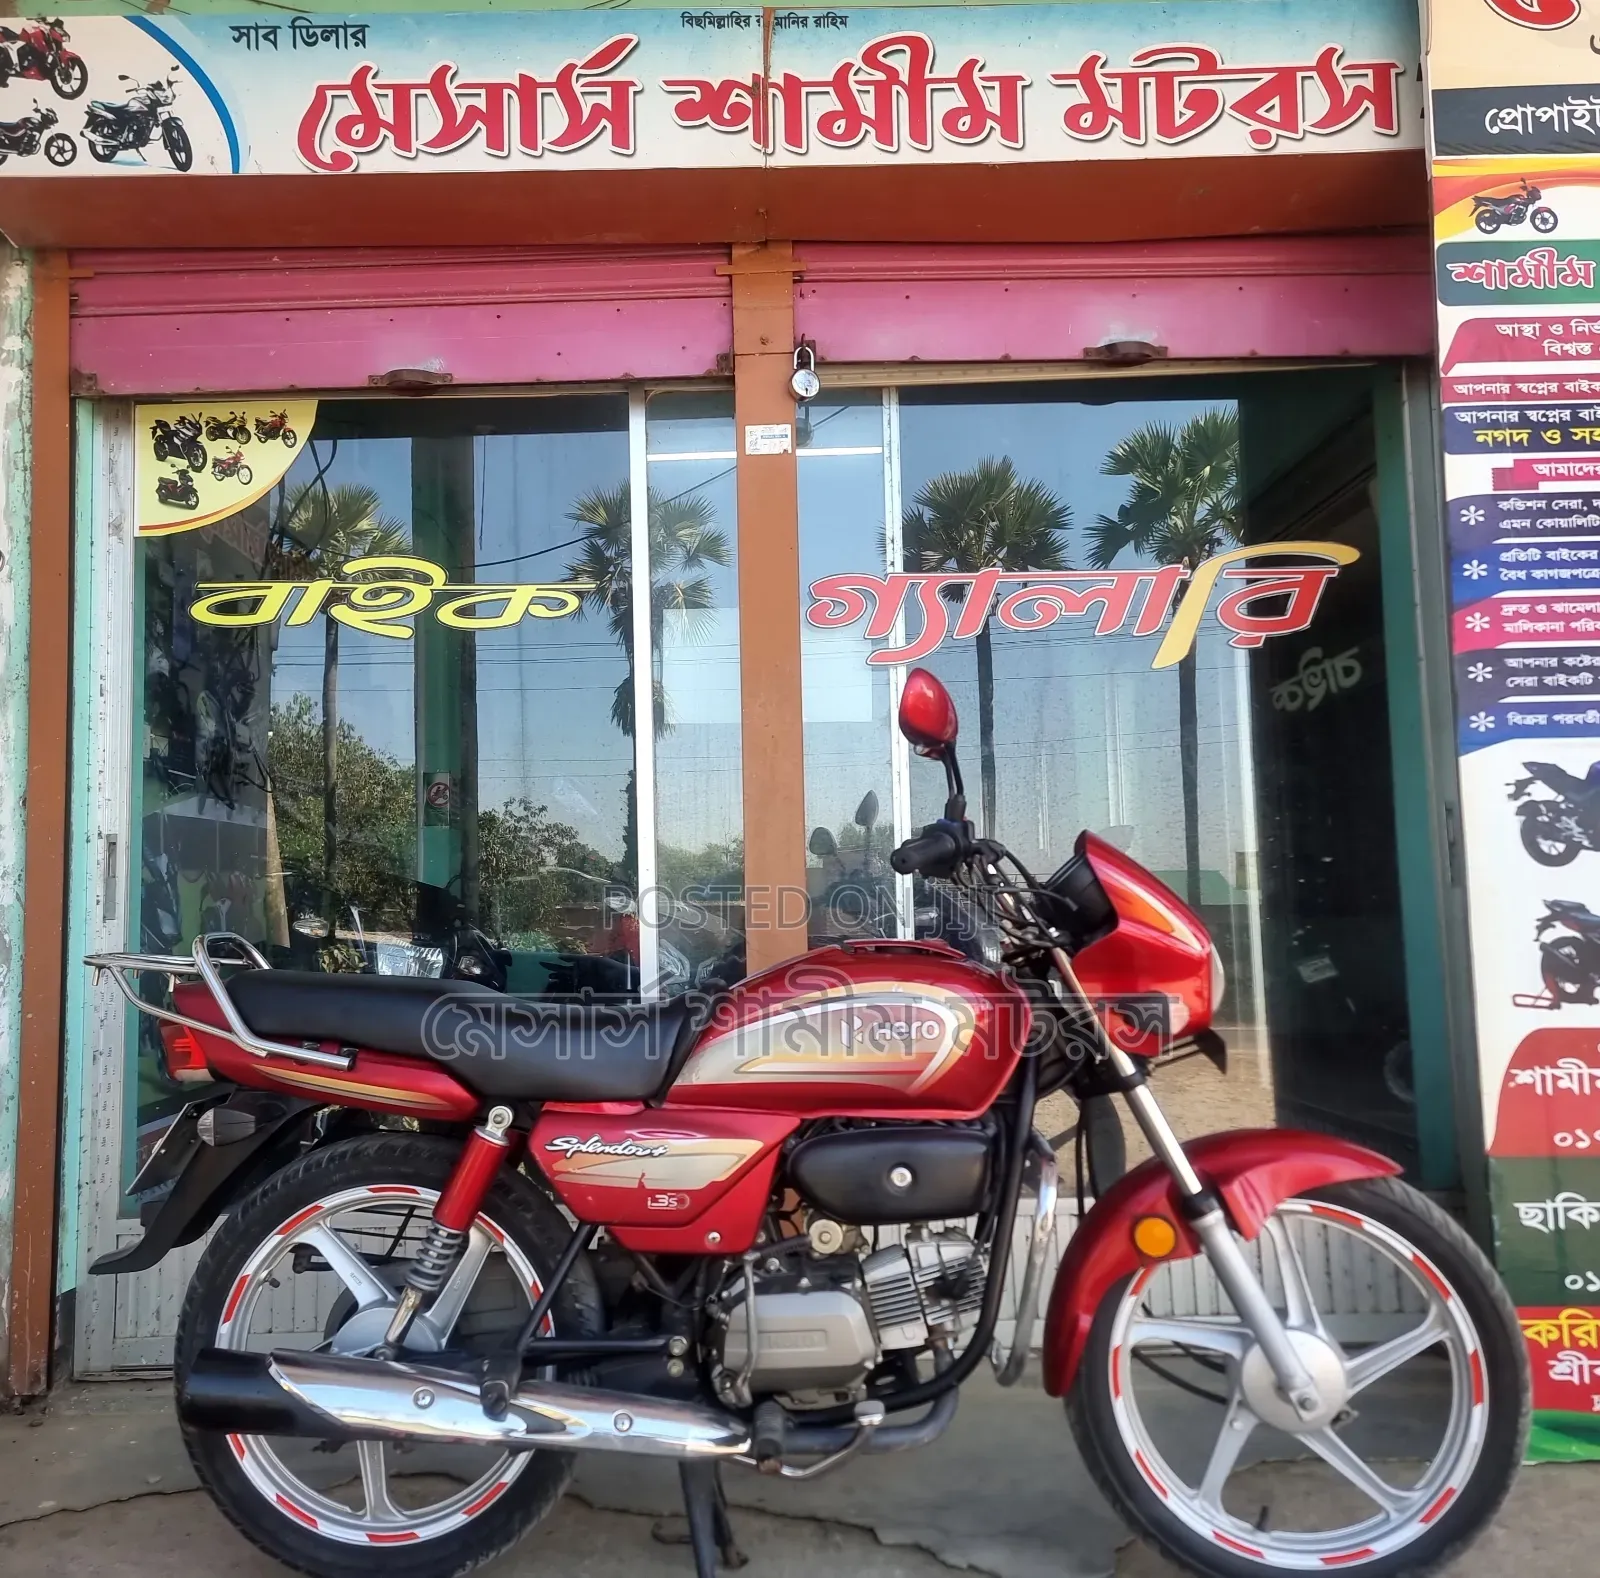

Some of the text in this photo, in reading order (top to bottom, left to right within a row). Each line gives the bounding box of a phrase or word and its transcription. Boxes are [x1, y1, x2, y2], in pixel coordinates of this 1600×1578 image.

[812, 12, 849, 30] রাহিম
[228, 15, 371, 51] সাব ডিলার
[297, 30, 1404, 173] মেসার্স শামীম মটরস
[1446, 246, 1597, 290] শামীম
[1495, 322, 1542, 339] আস্থা
[1548, 323, 1564, 336] ও
[1541, 338, 1594, 357] বিশ্বস্ত
[1453, 382, 1512, 396] আপনার
[1515, 381, 1560, 396] স্বপ্নের
[1454, 410, 1521, 425] আপনার
[1524, 409, 1572, 424] স্বপ্নের
[1473, 427, 1532, 447] নগদ
[1541, 428, 1562, 445] ও
[1498, 518, 1531, 530] এমন
[188, 540, 1361, 670] বাইক গ্যালারি
[1518, 1307, 1600, 1349] করি
